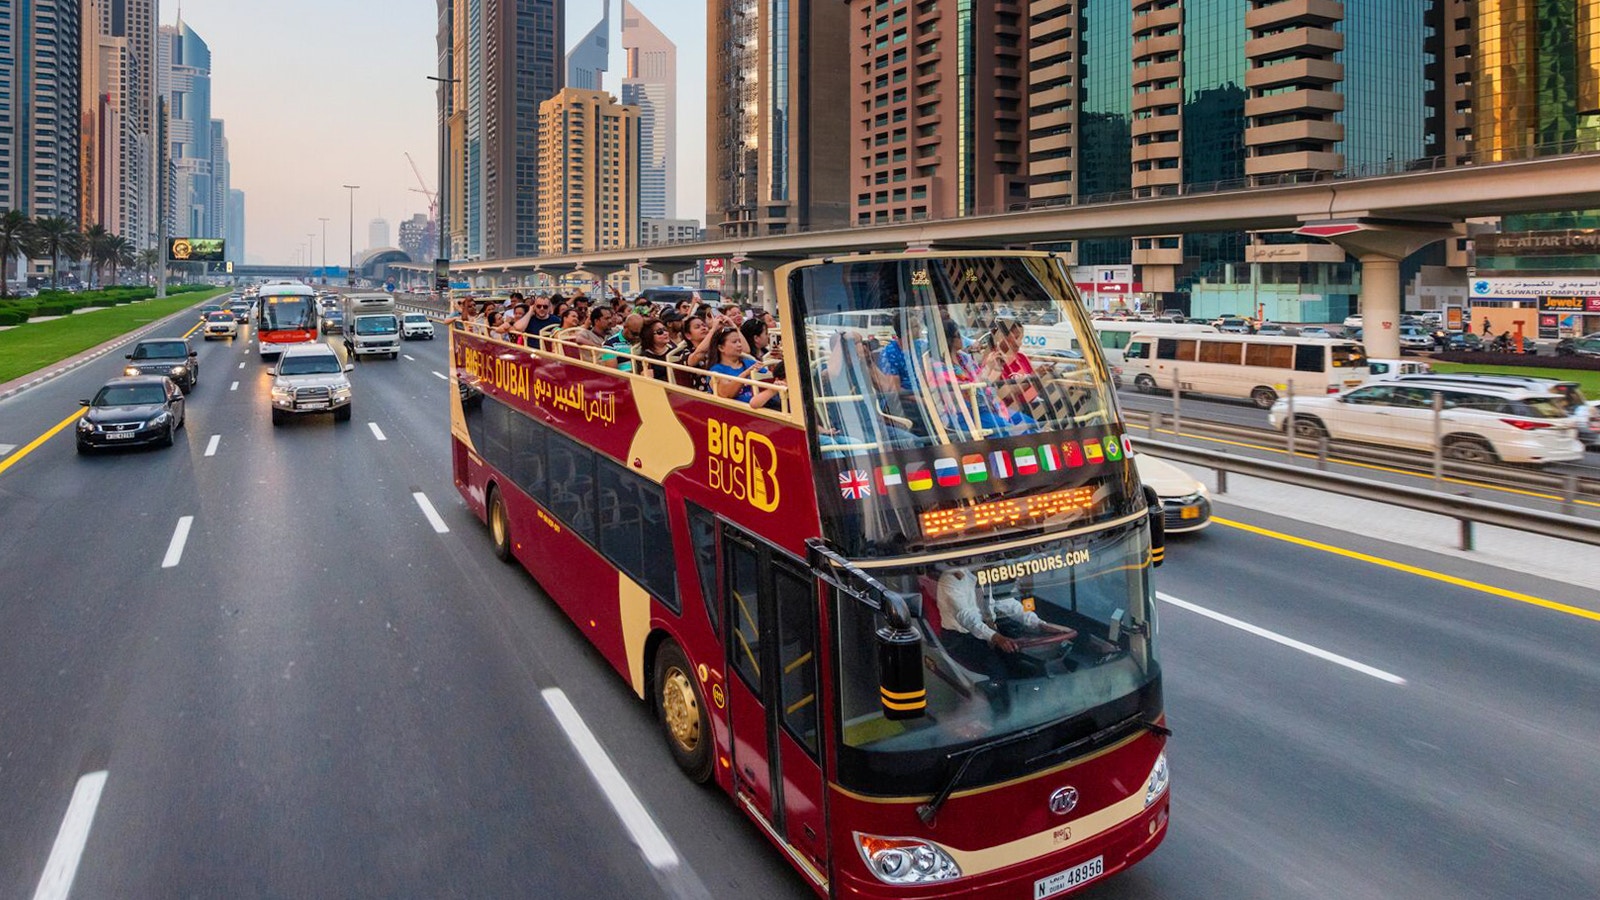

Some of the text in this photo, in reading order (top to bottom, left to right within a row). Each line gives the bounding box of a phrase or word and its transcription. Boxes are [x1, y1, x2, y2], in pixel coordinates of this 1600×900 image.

[1497, 238, 1514, 247] AL
[1517, 236, 1560, 247] ATTAR
[1022, 335, 1047, 346] OUQ
[495, 358, 530, 401] DUBAI
[708, 417, 745, 464] BIG
[708, 455, 746, 501] BUS
[977, 549, 1090, 586] BIGBUSTOURS.COM
[1039, 859, 1102, 897] N 48956
